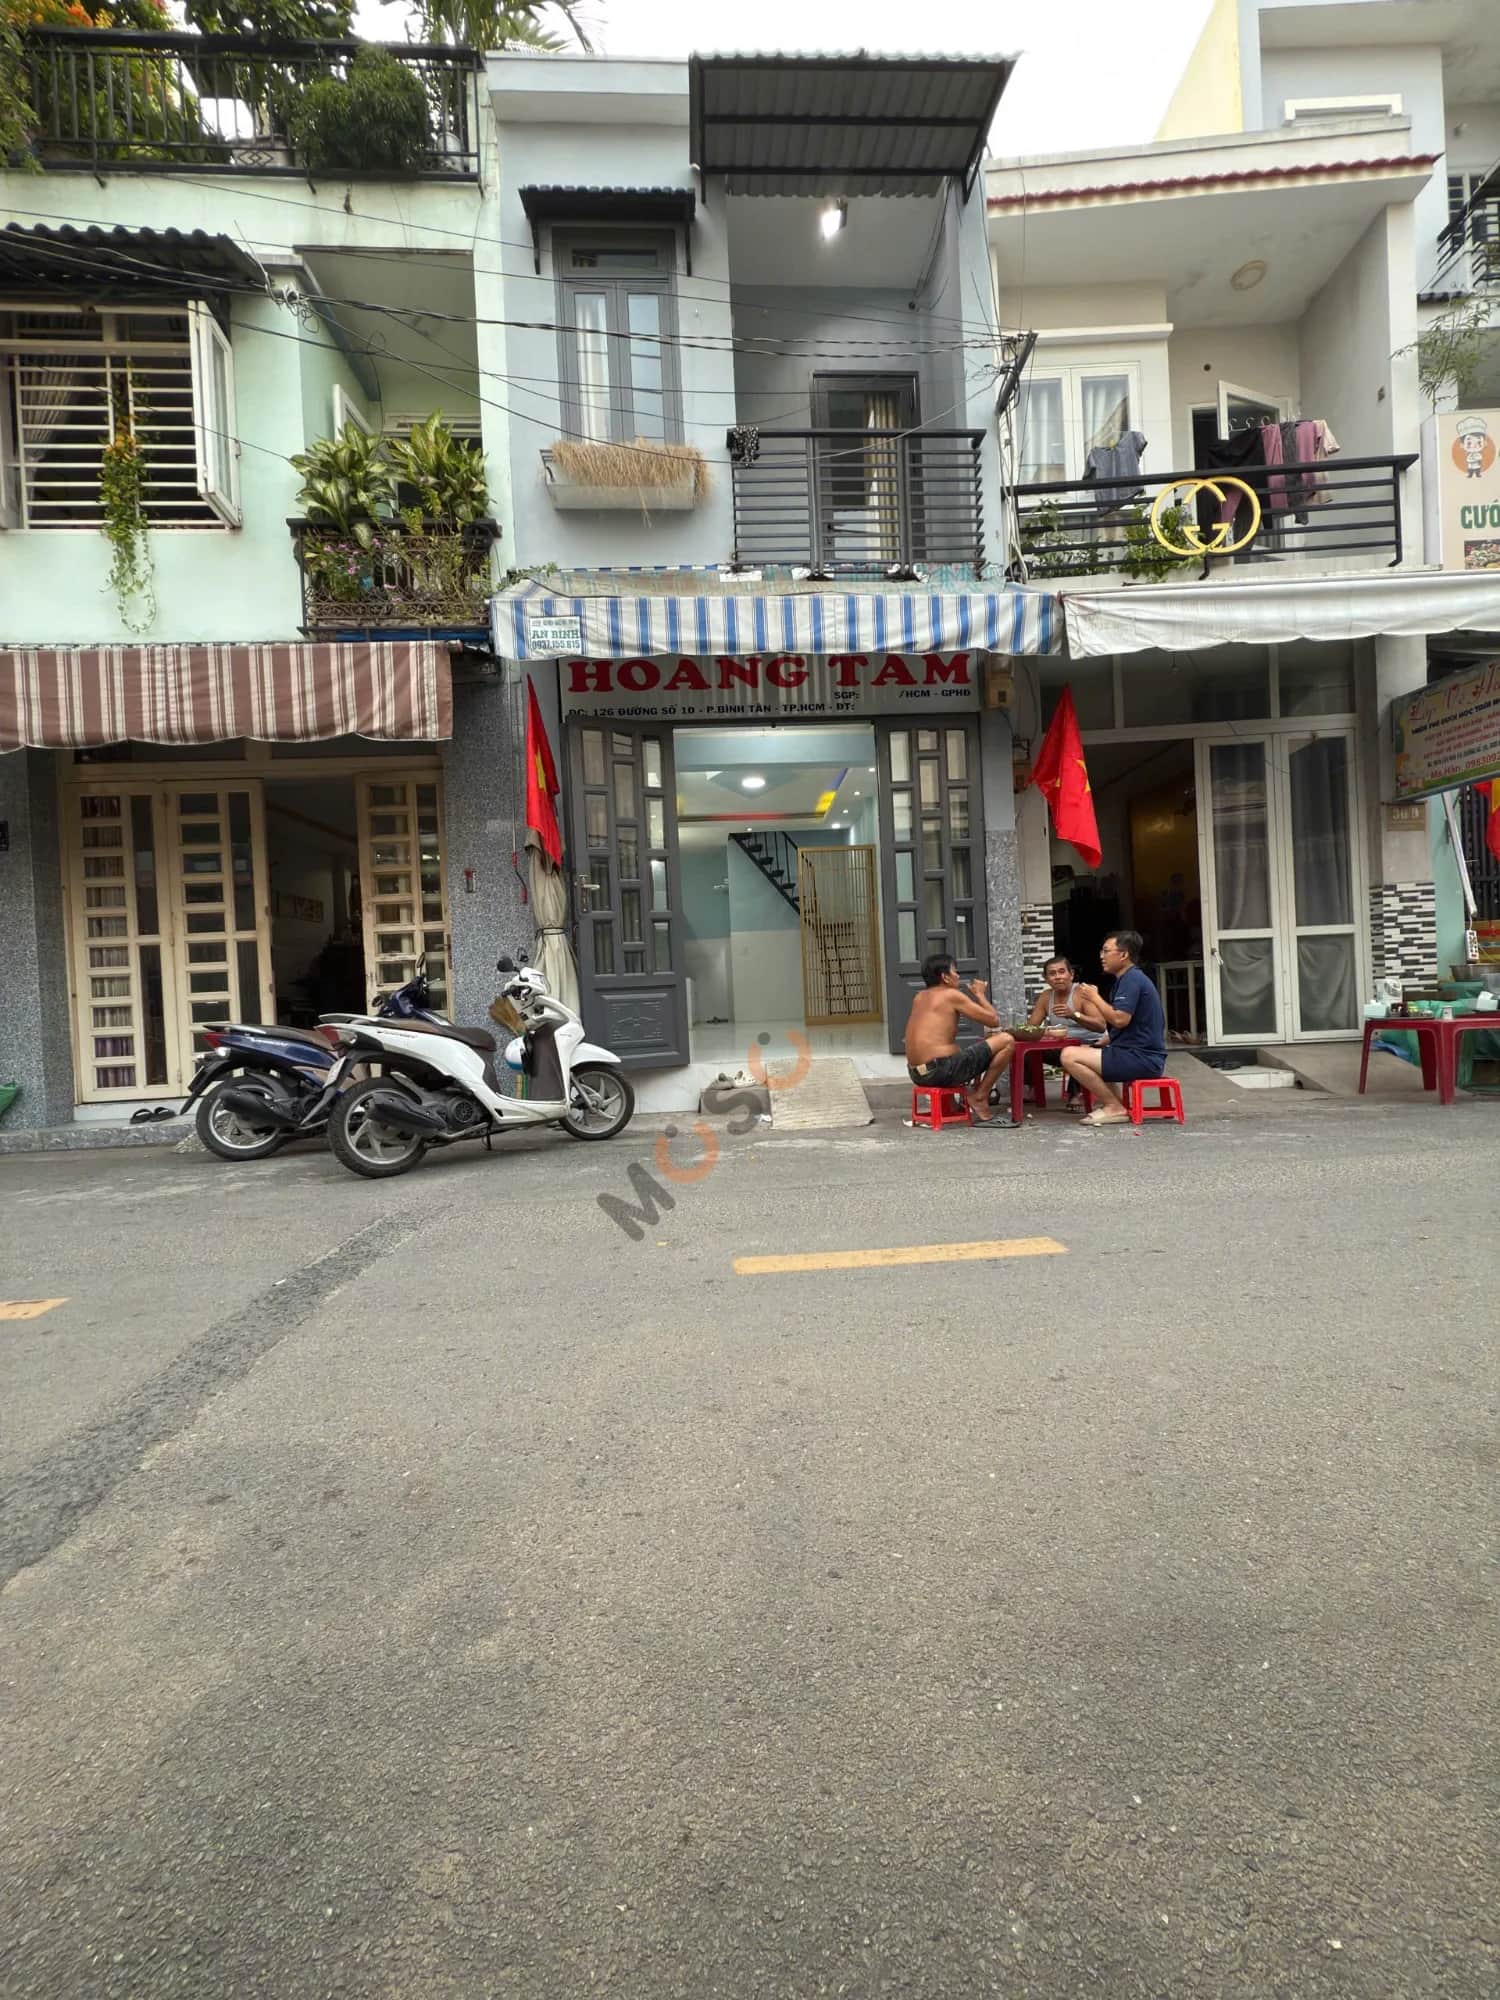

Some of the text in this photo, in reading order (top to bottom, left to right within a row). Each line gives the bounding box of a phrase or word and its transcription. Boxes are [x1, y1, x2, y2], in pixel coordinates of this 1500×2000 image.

[593, 707, 614, 717] 126
[681, 706, 695, 715] 10
[782, 703, 825, 712] TP.HCM
